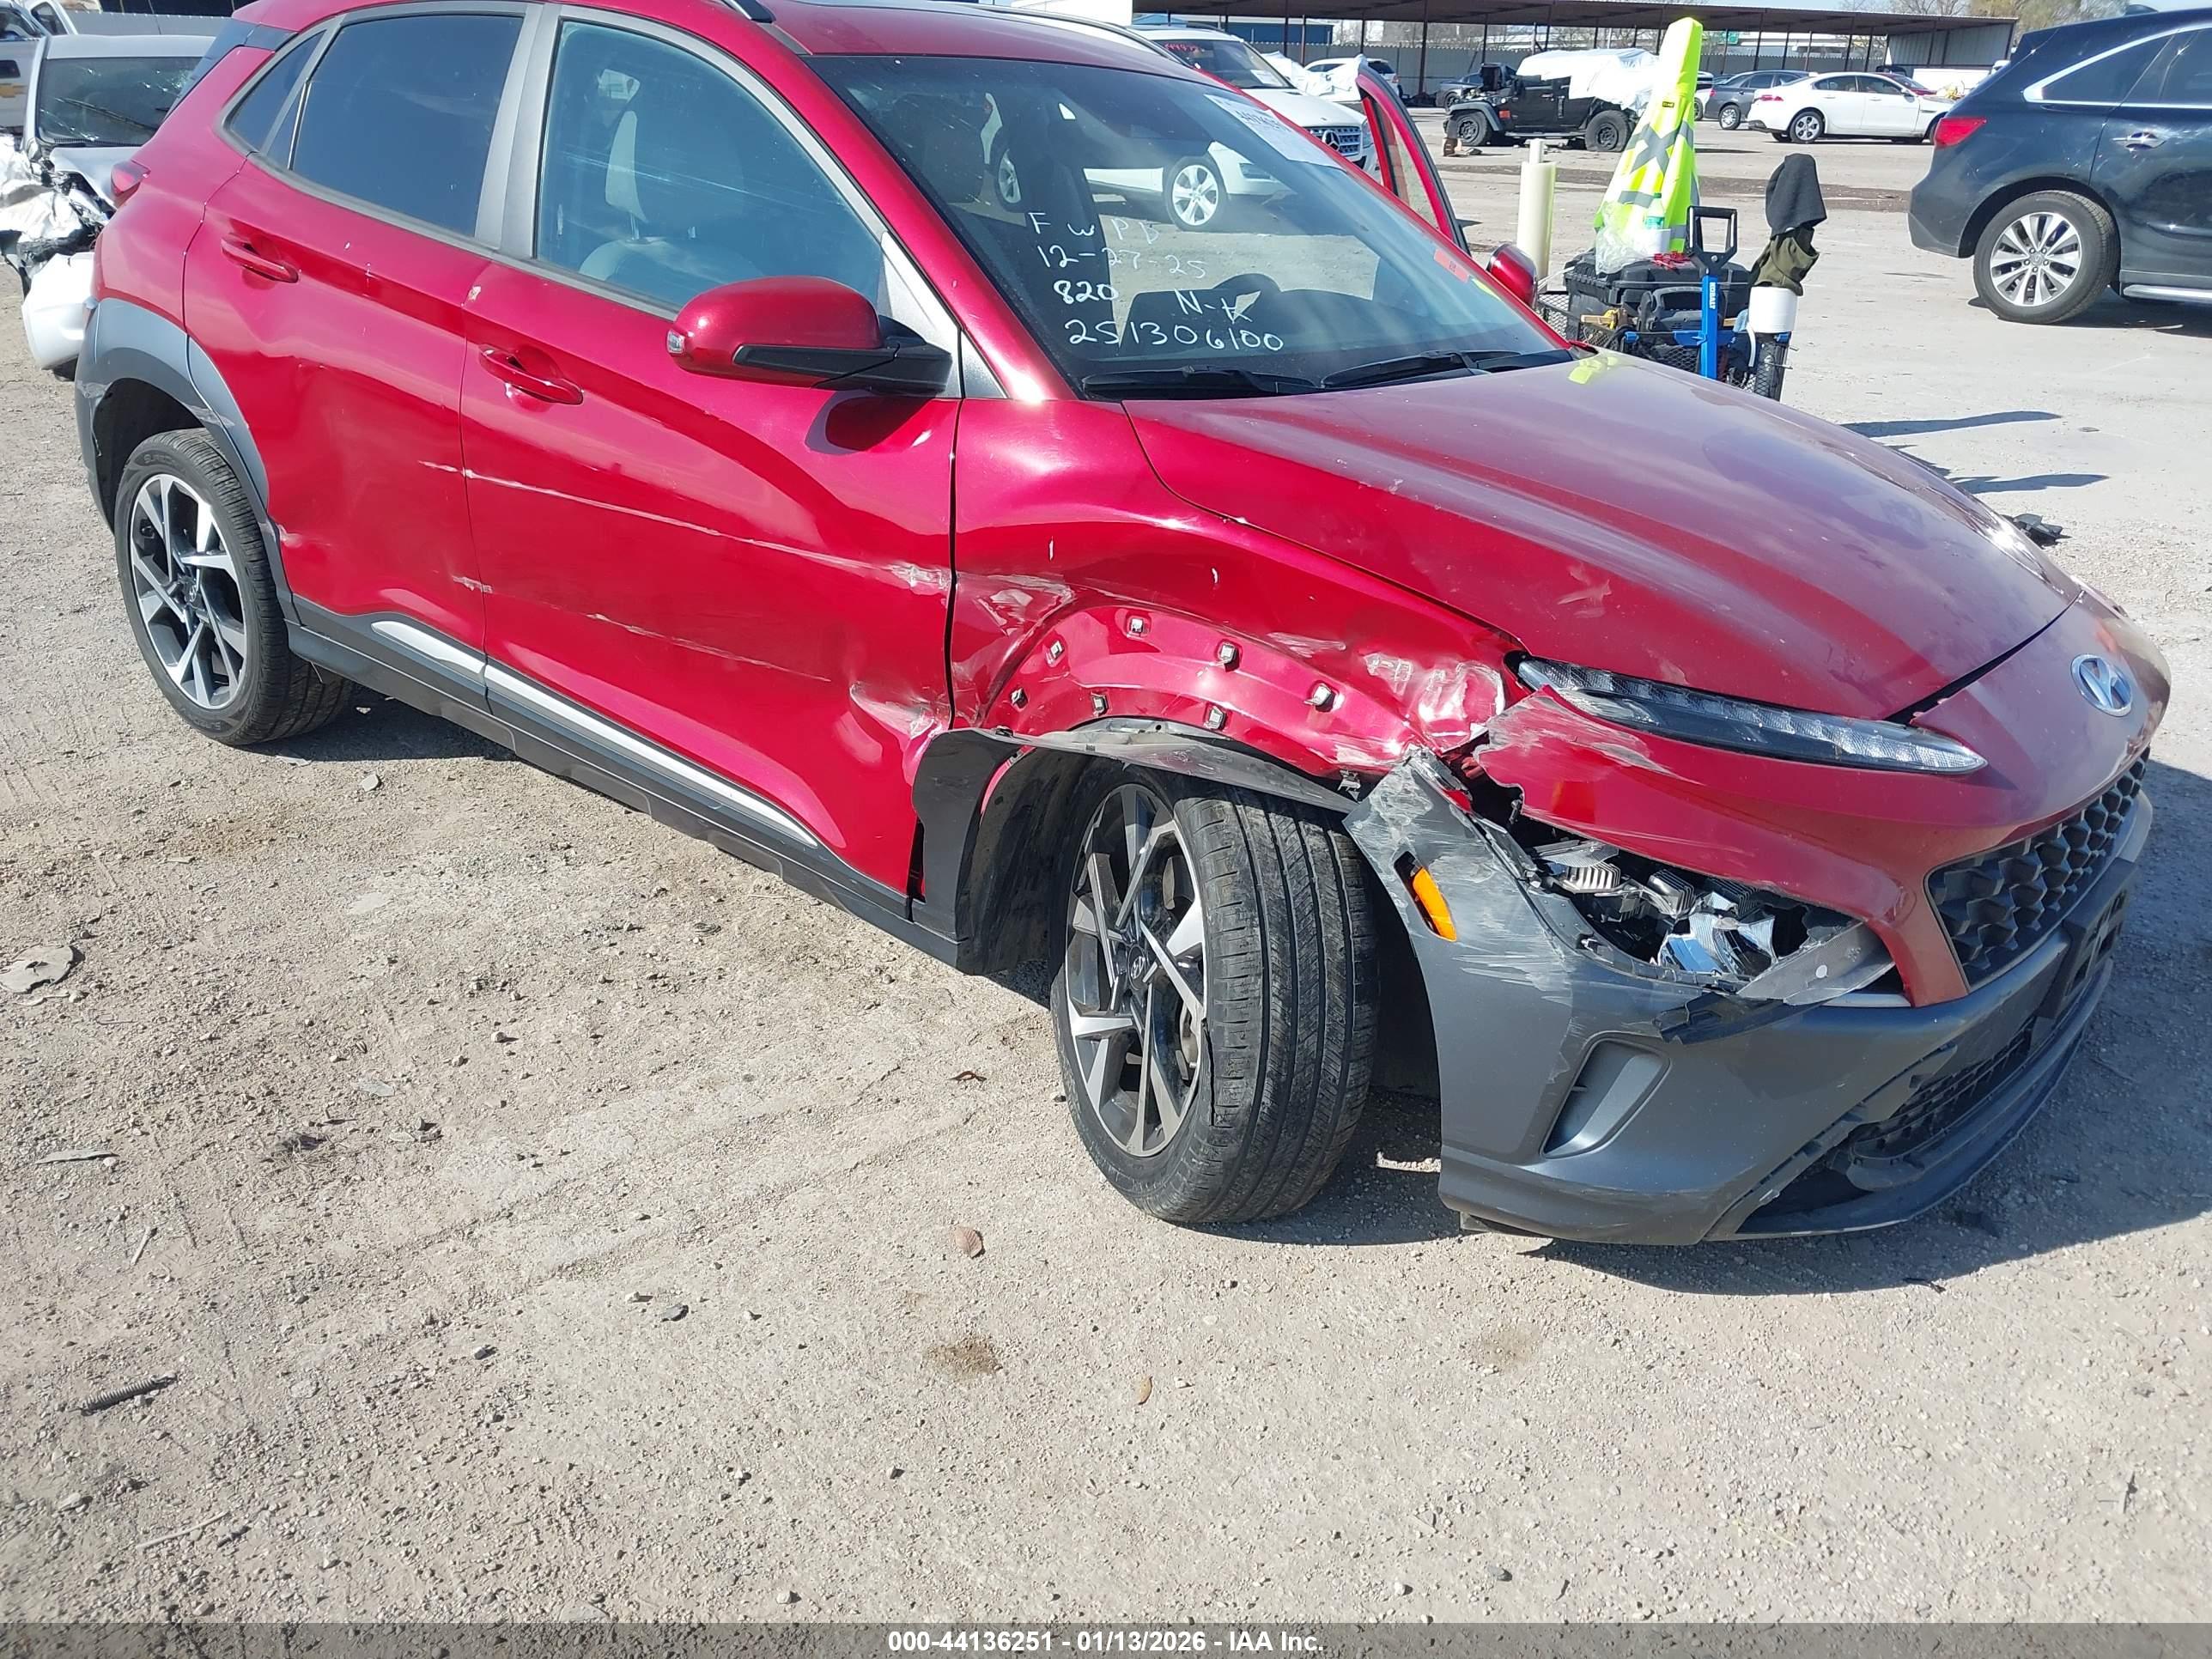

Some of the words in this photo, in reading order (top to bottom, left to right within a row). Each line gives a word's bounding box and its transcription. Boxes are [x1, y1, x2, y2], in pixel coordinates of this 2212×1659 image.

[1036, 245, 1208, 278] 12-27-25
[1053, 280, 1120, 304] 820
[1064, 319, 1284, 350] 251306100
